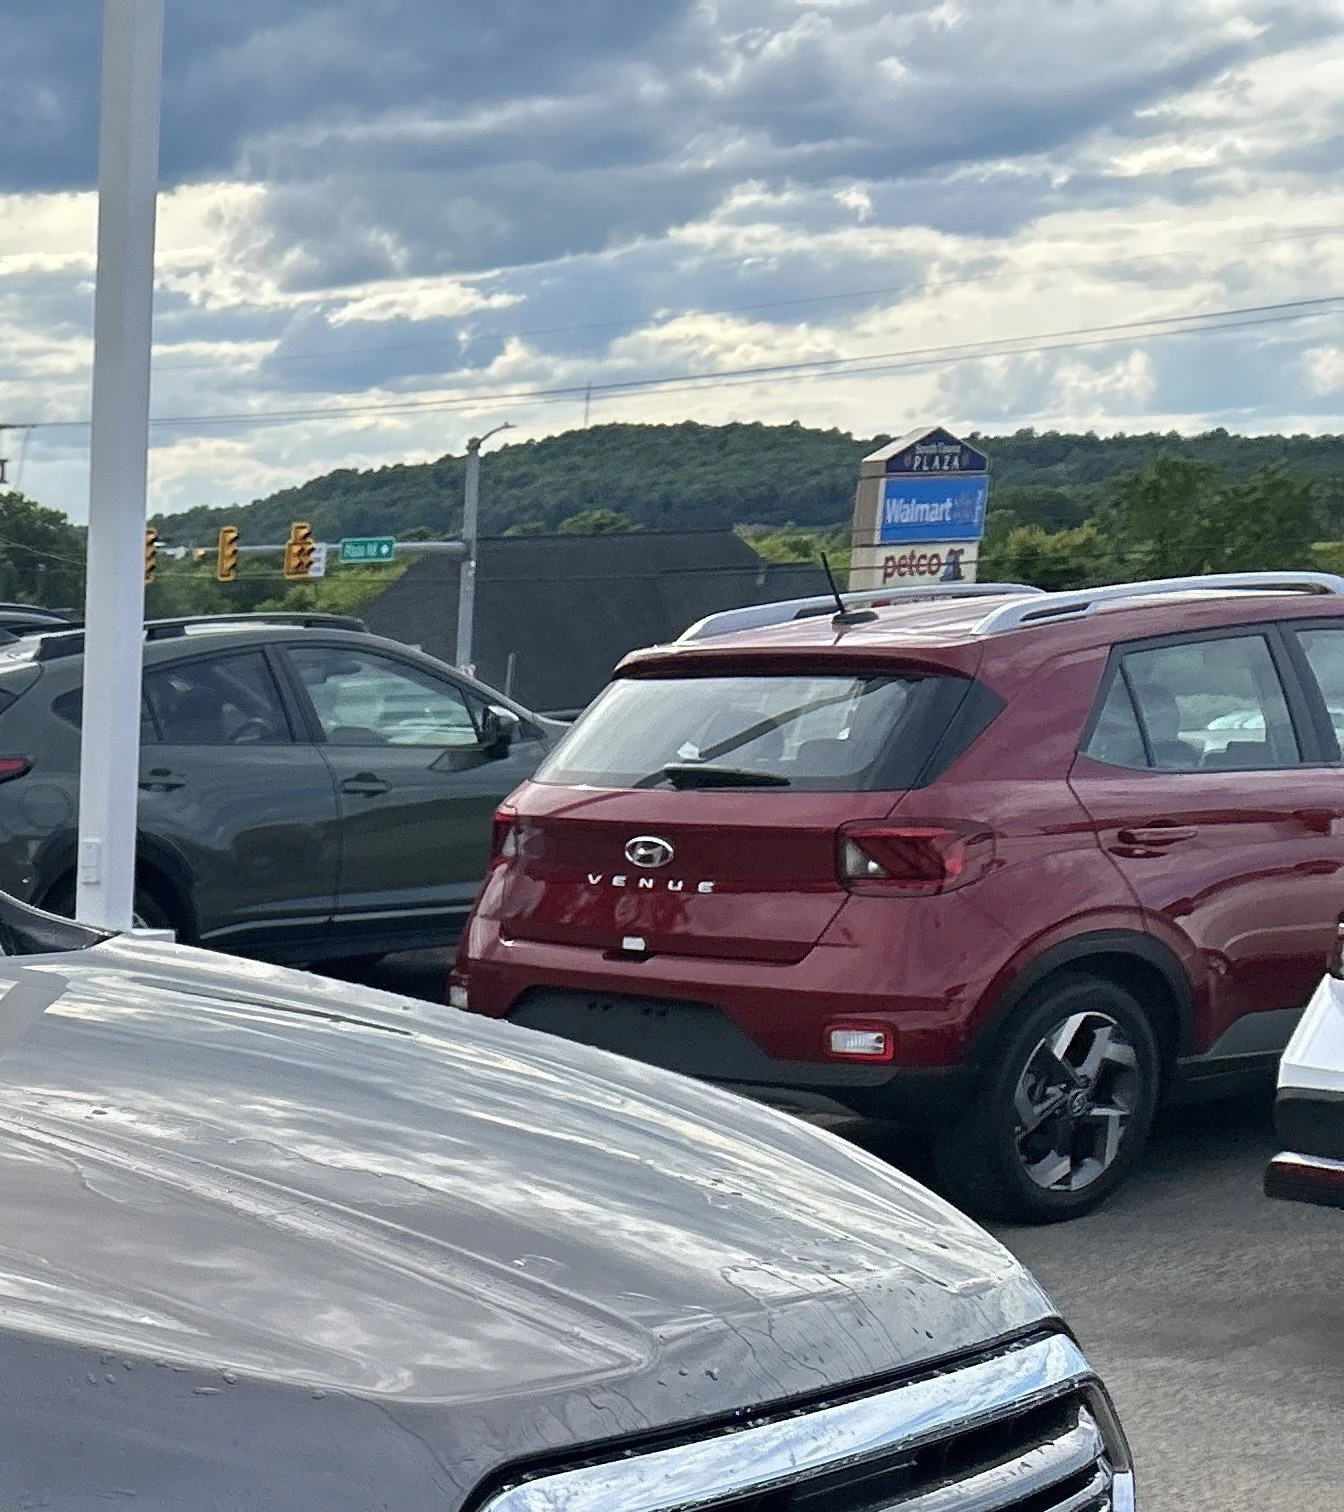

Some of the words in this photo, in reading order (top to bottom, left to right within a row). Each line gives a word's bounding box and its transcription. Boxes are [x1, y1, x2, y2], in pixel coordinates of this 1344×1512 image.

[913, 455, 960, 471] PLAZA
[885, 498, 952, 524] Walmart
[883, 551, 941, 584] petco
[588, 873, 714, 893] VENUE
